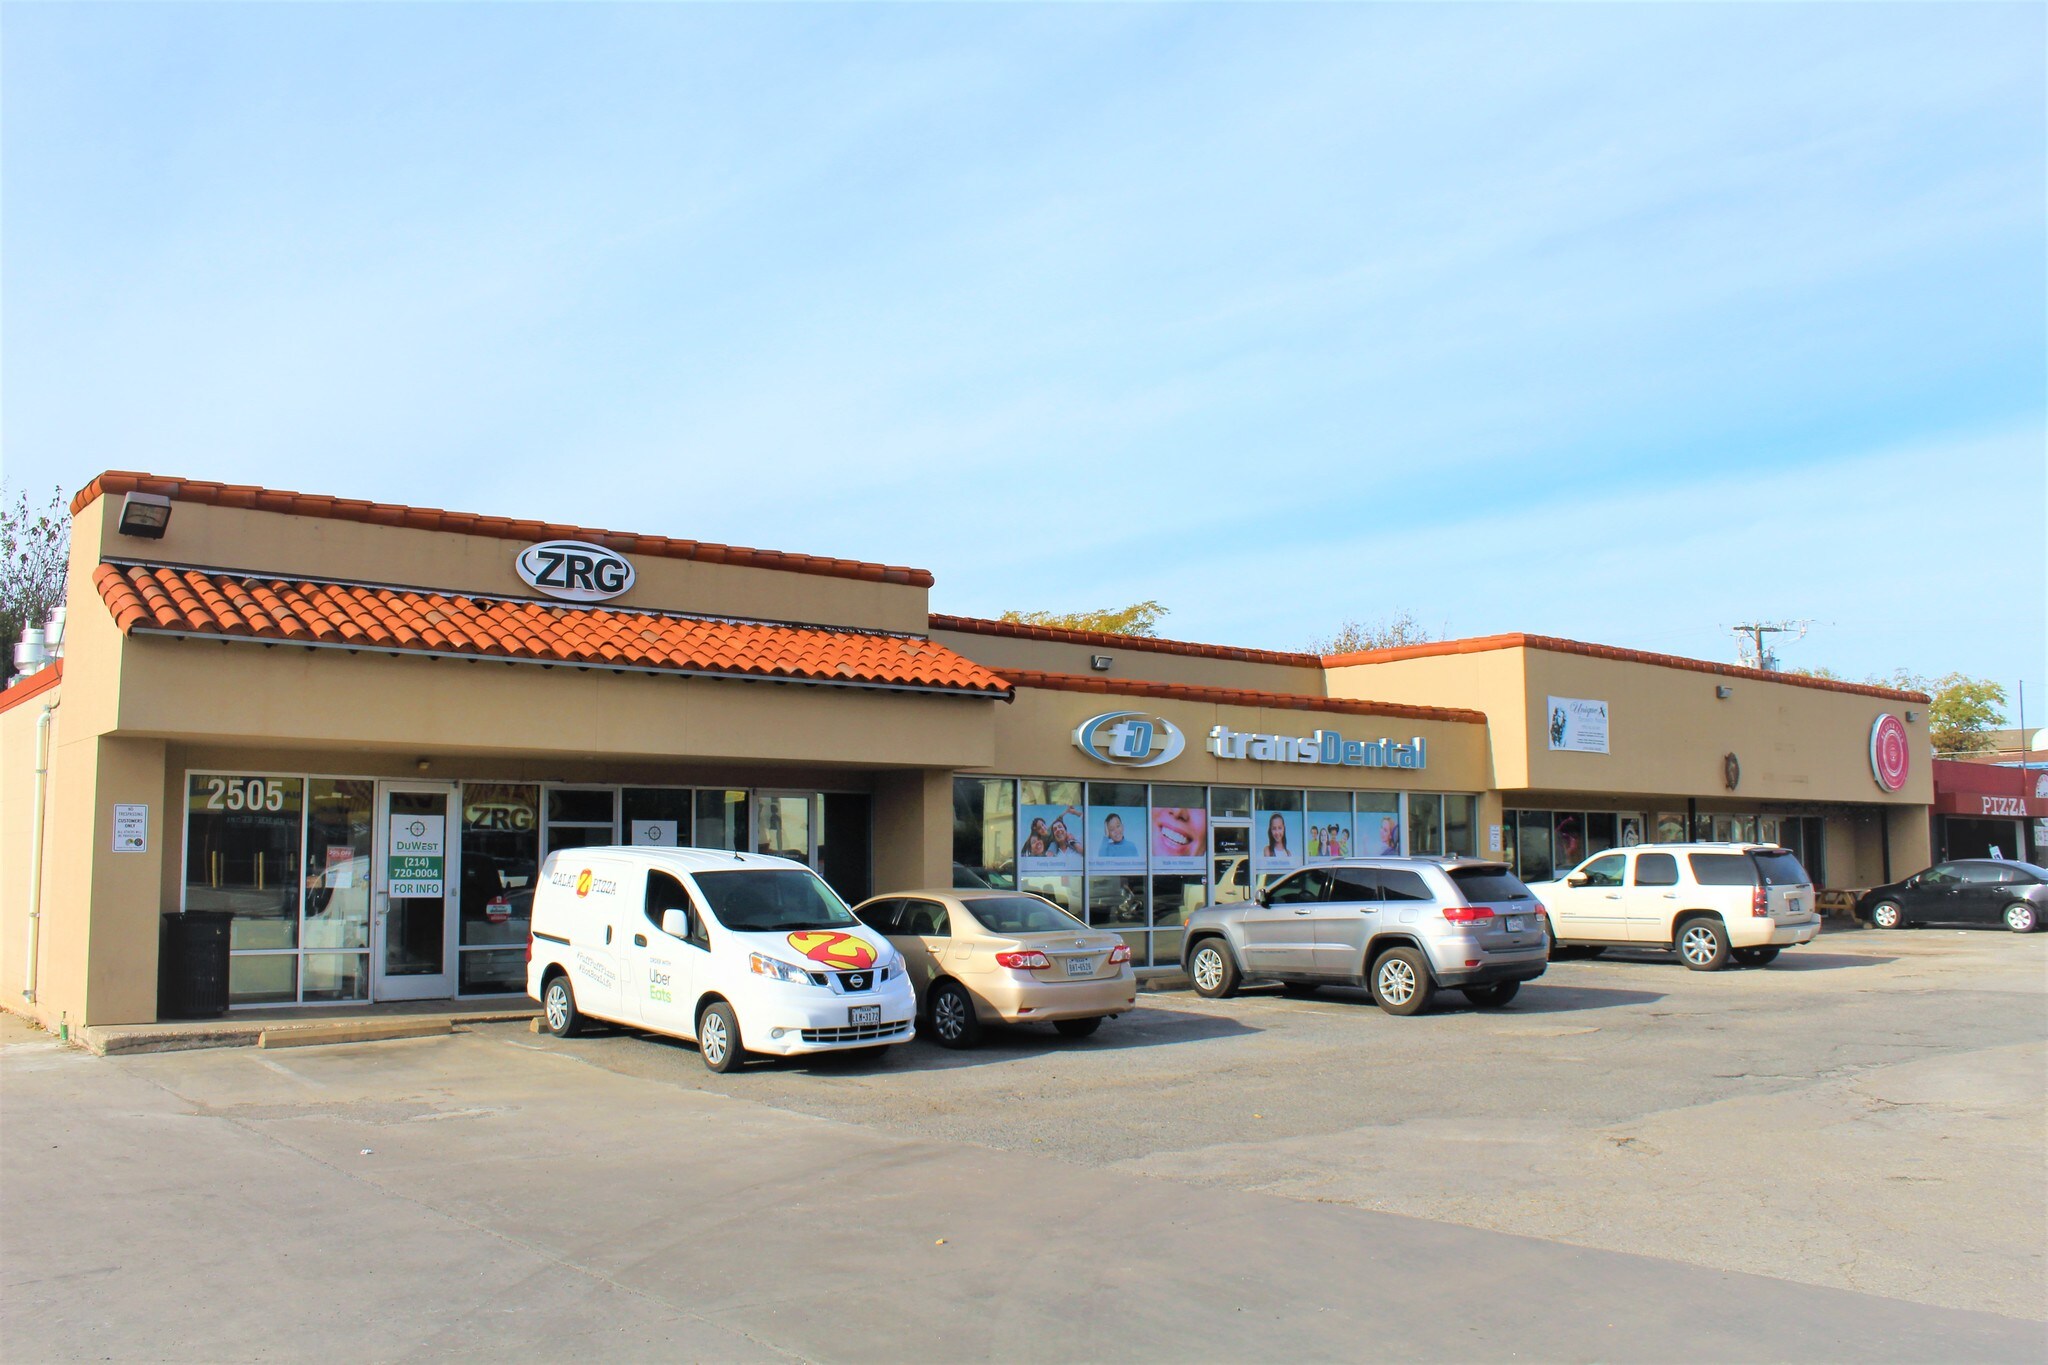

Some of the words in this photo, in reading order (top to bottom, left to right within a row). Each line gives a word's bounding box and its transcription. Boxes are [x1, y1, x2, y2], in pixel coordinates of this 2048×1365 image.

[535, 550, 625, 593] ZRG
[1570, 703, 1599, 717] Unique
[1209, 725, 1427, 769] transDental
[207, 779, 283, 811] 2505
[1981, 796, 2028, 816] PIZZA
[470, 806, 532, 831] ZRG
[405, 857, 429, 868] (214)
[394, 868, 438, 878] 720-0004
[394, 883, 413, 894] FOR
[416, 883, 439, 894] INFO
[552, 872, 577, 888] ZALAT
[591, 878, 617, 896] PIZZA
[649, 967, 671, 986] Uber
[650, 984, 672, 1003] Eats
